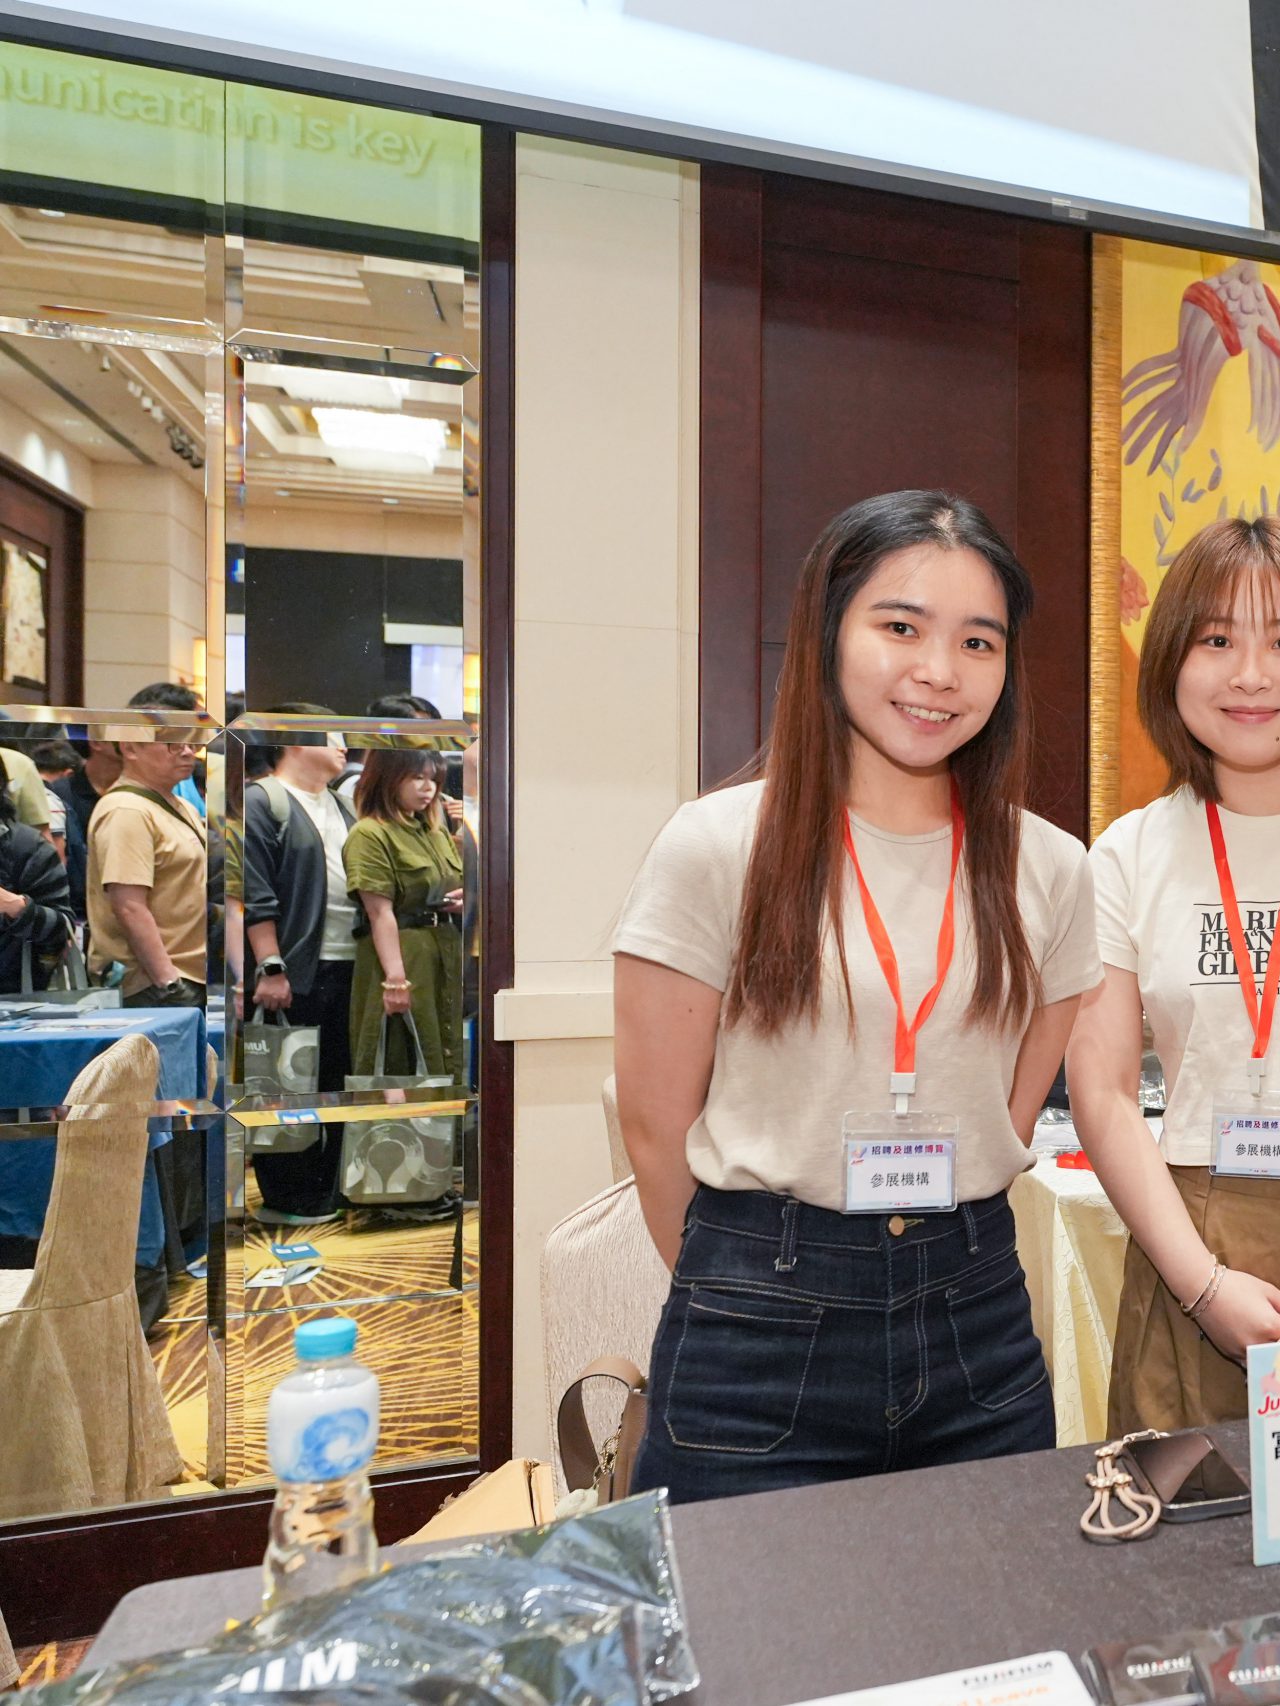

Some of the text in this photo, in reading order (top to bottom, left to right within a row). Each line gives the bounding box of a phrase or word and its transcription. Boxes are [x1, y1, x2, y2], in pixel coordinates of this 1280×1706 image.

[295, 105, 335, 151] is
[346, 112, 435, 177] key
[869, 1171, 930, 1188] 參展機構
